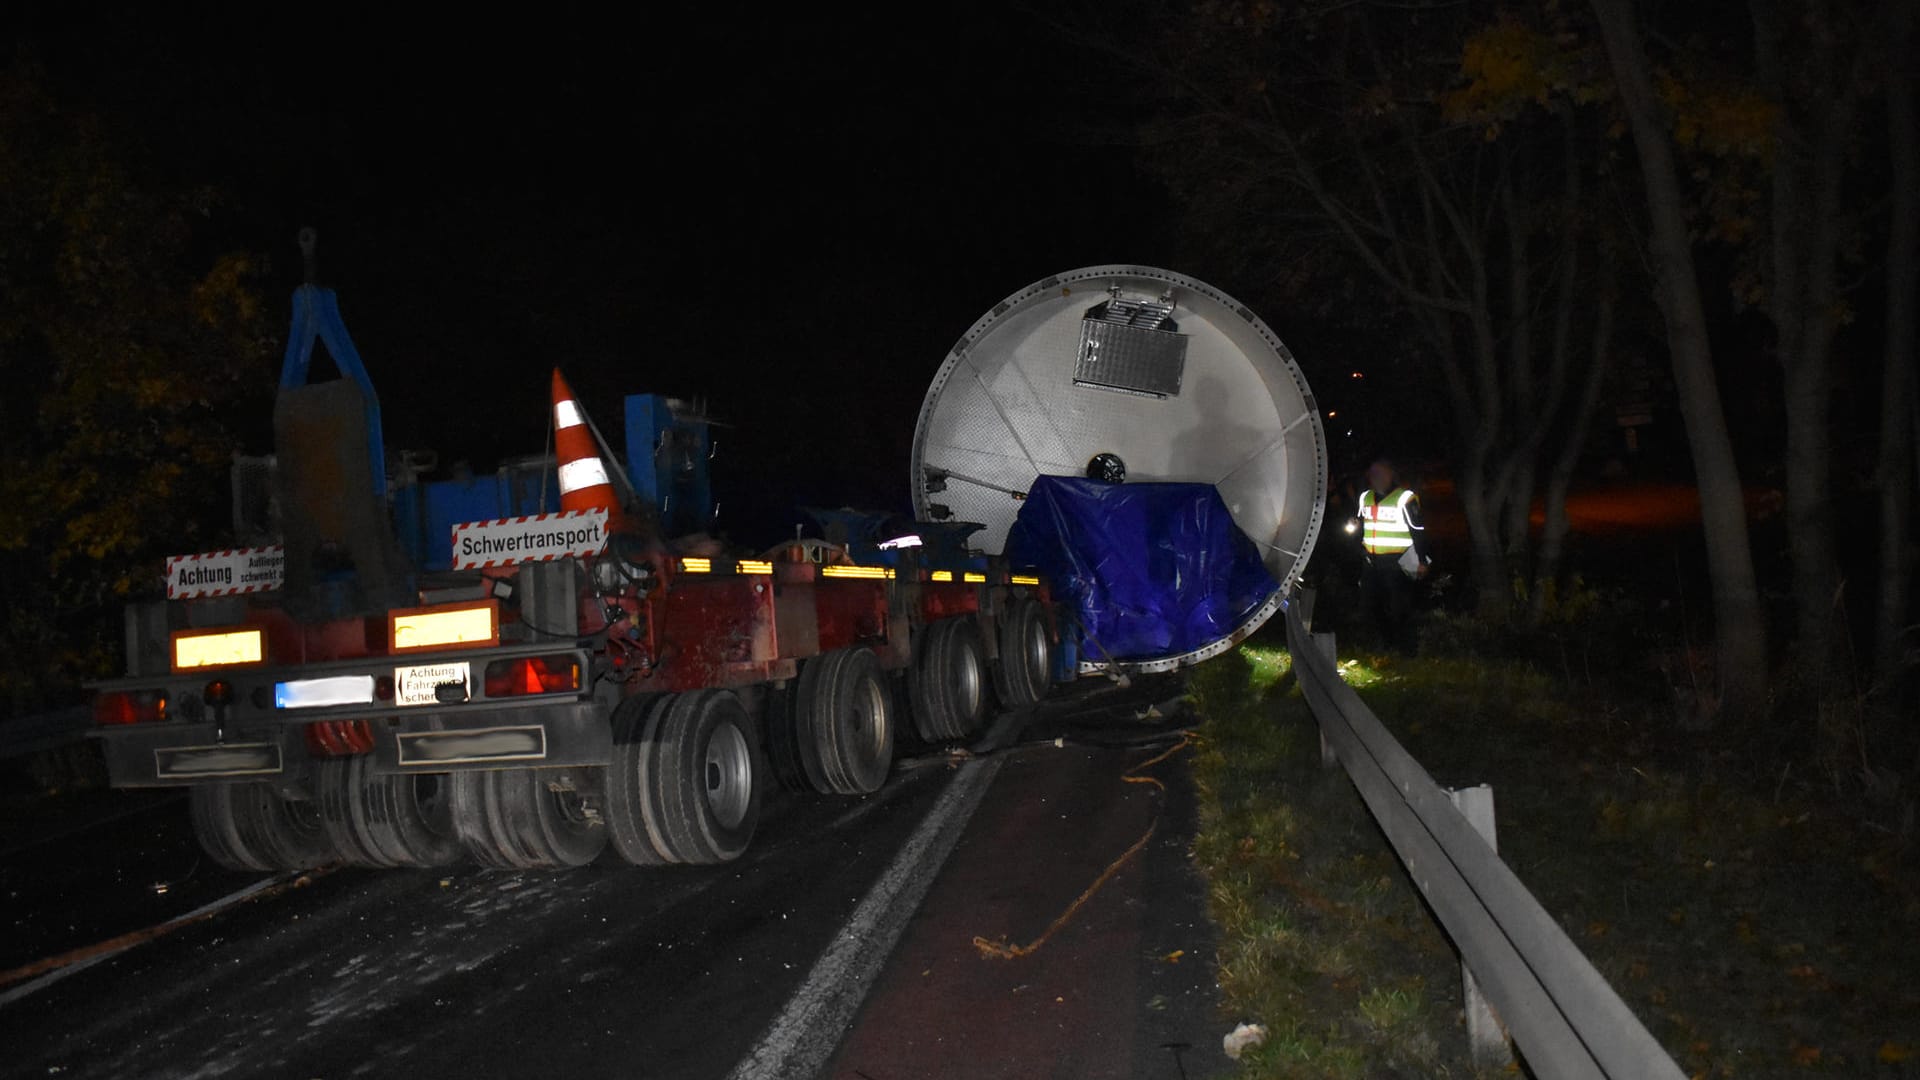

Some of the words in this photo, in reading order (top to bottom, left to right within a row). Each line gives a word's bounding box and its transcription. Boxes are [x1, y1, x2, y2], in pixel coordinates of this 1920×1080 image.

[462, 524, 600, 556] Schwertransport
[179, 566, 232, 586] Achtung
[409, 667, 455, 678] Achtung
[405, 693, 436, 703] scher
